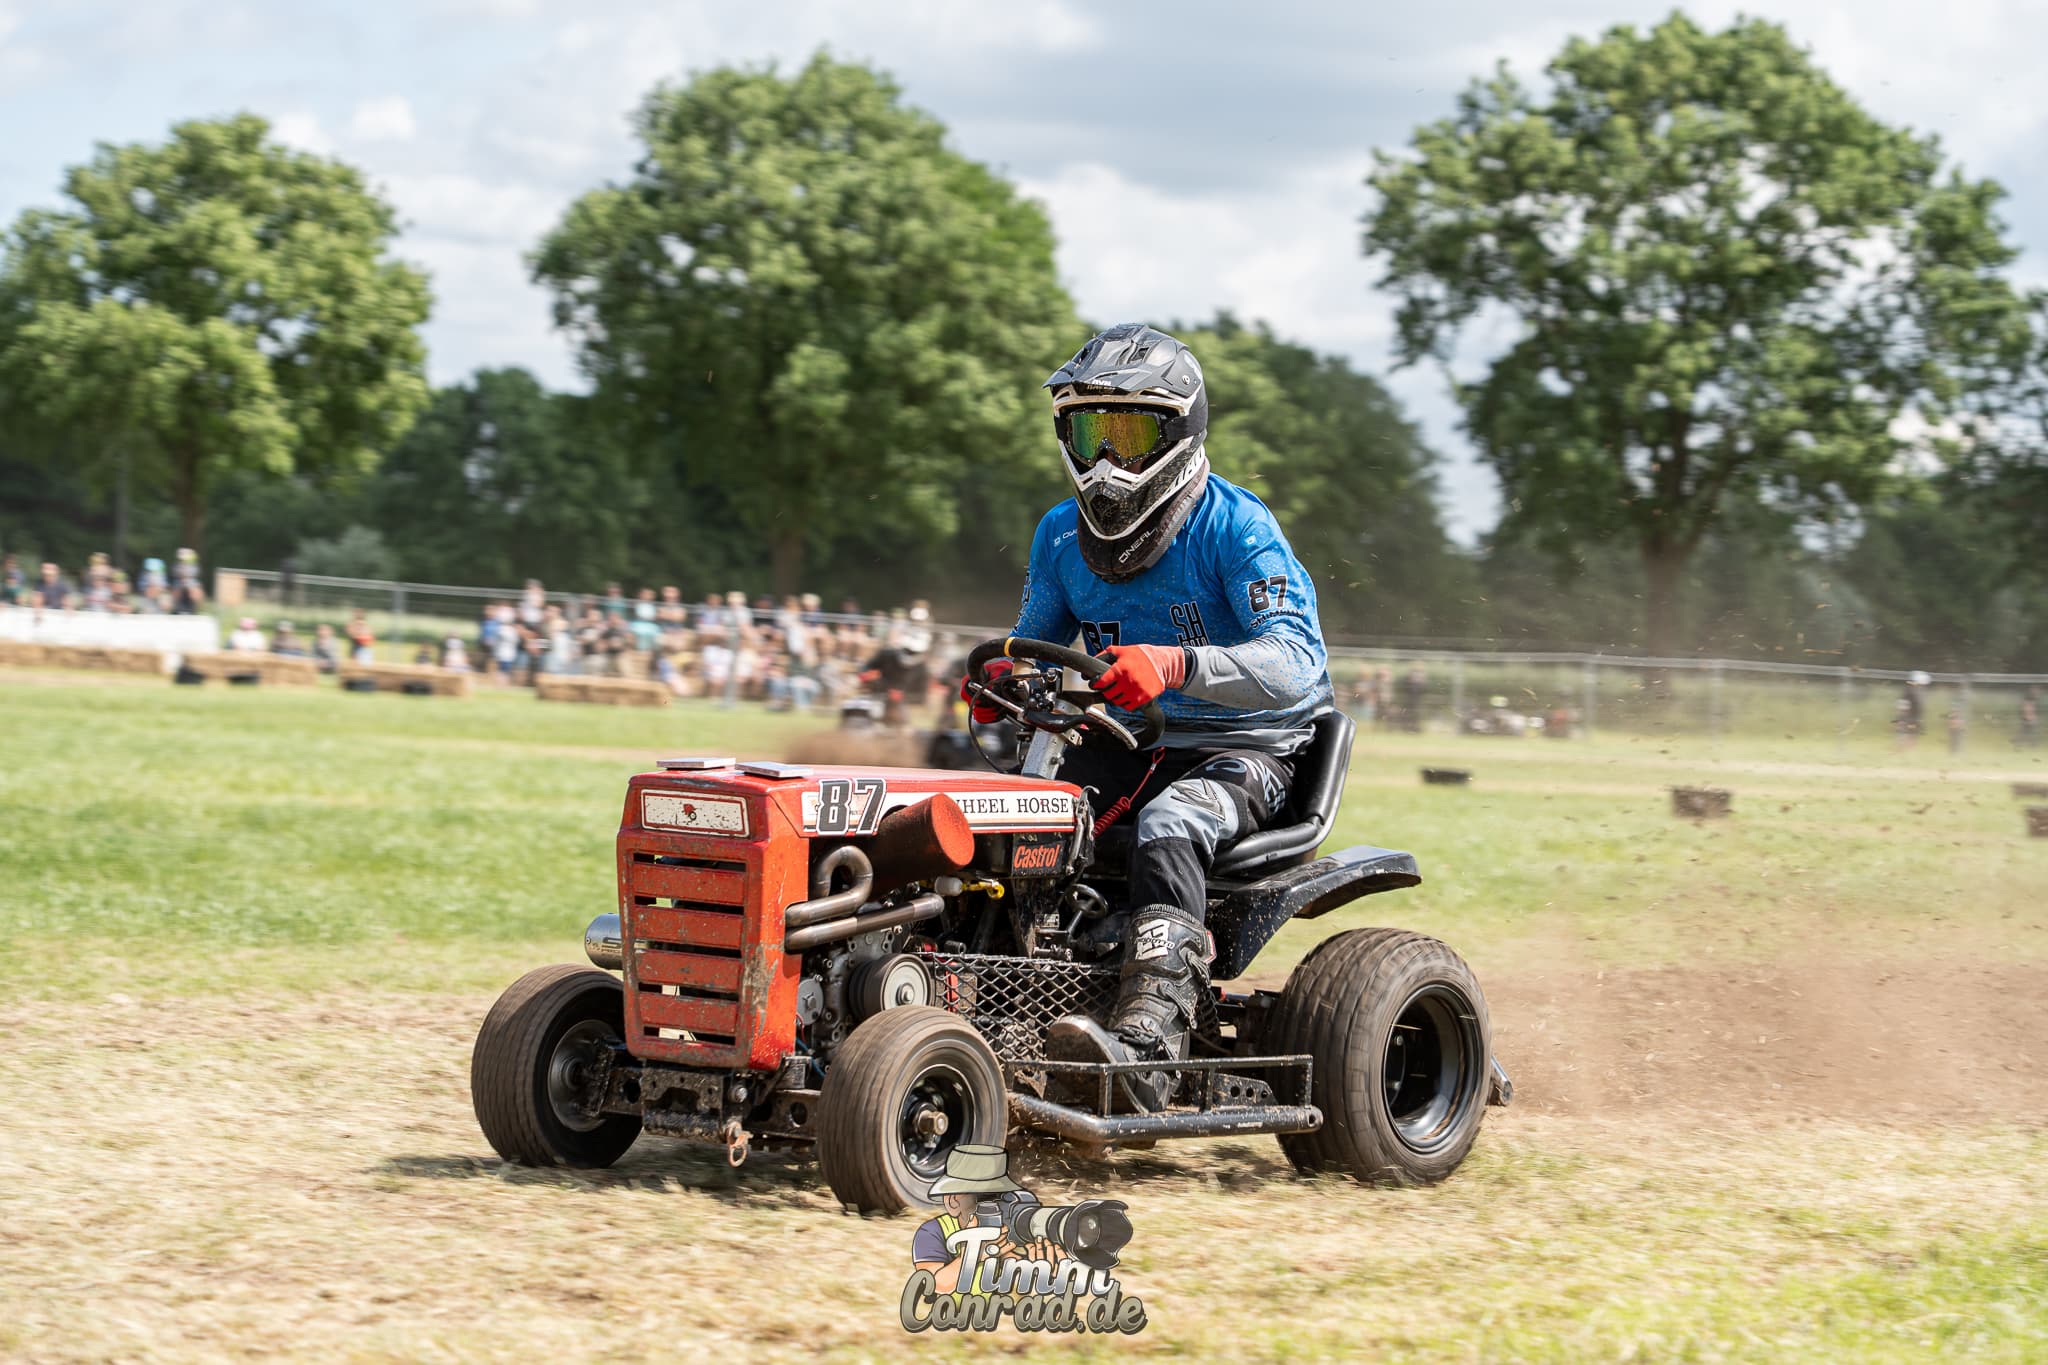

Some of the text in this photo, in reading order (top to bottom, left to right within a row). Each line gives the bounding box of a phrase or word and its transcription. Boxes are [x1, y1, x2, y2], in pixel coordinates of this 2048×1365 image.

[1247, 574, 1288, 614] 87
[1170, 600, 1210, 646] SH
[816, 778, 887, 836] 87
[956, 797, 1069, 814] HEEL HORSE
[1013, 844, 1061, 869] Castrol
